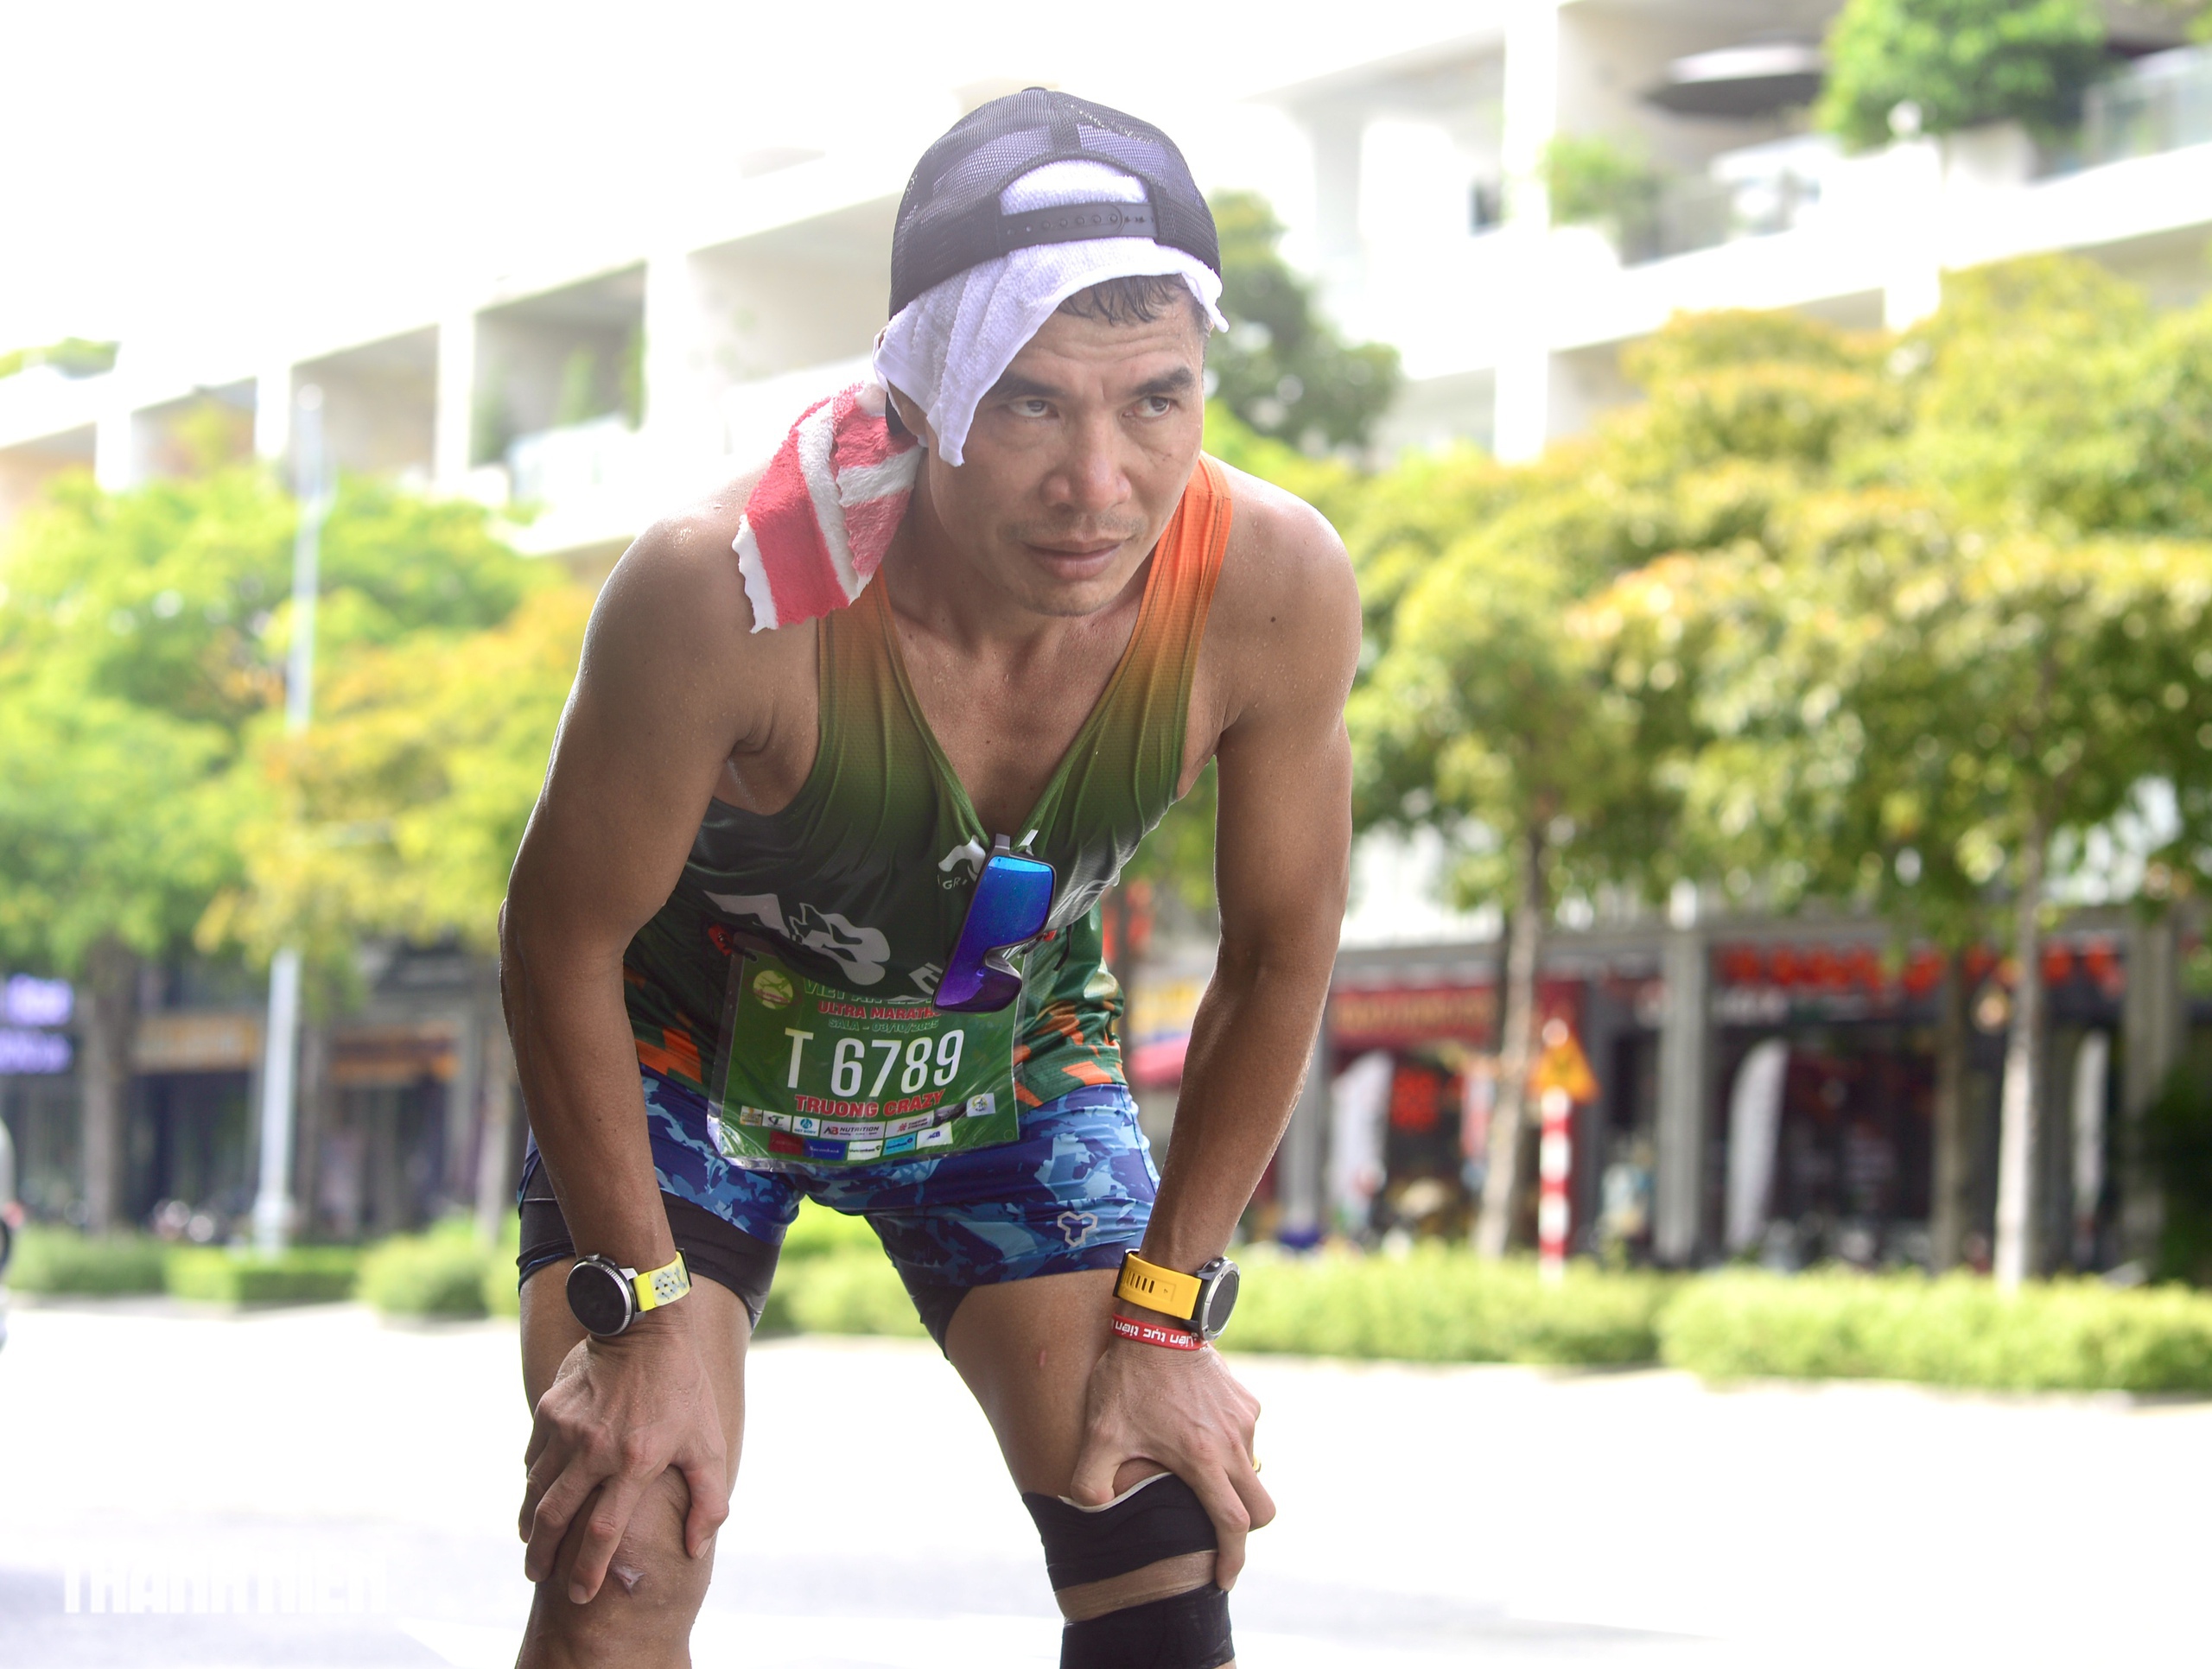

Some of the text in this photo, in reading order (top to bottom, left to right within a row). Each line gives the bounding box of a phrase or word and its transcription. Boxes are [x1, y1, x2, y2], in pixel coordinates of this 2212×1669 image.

[817, 1000, 867, 1019] ULTRA
[869, 1005, 942, 1021] MARATH
[828, 1018, 860, 1031] SALA
[872, 1019, 939, 1034] 03/10/2025
[785, 1027, 965, 1098] T 6789
[794, 1088, 946, 1118] TRUONG CRAZY
[1142, 1328, 1166, 1343] tục
